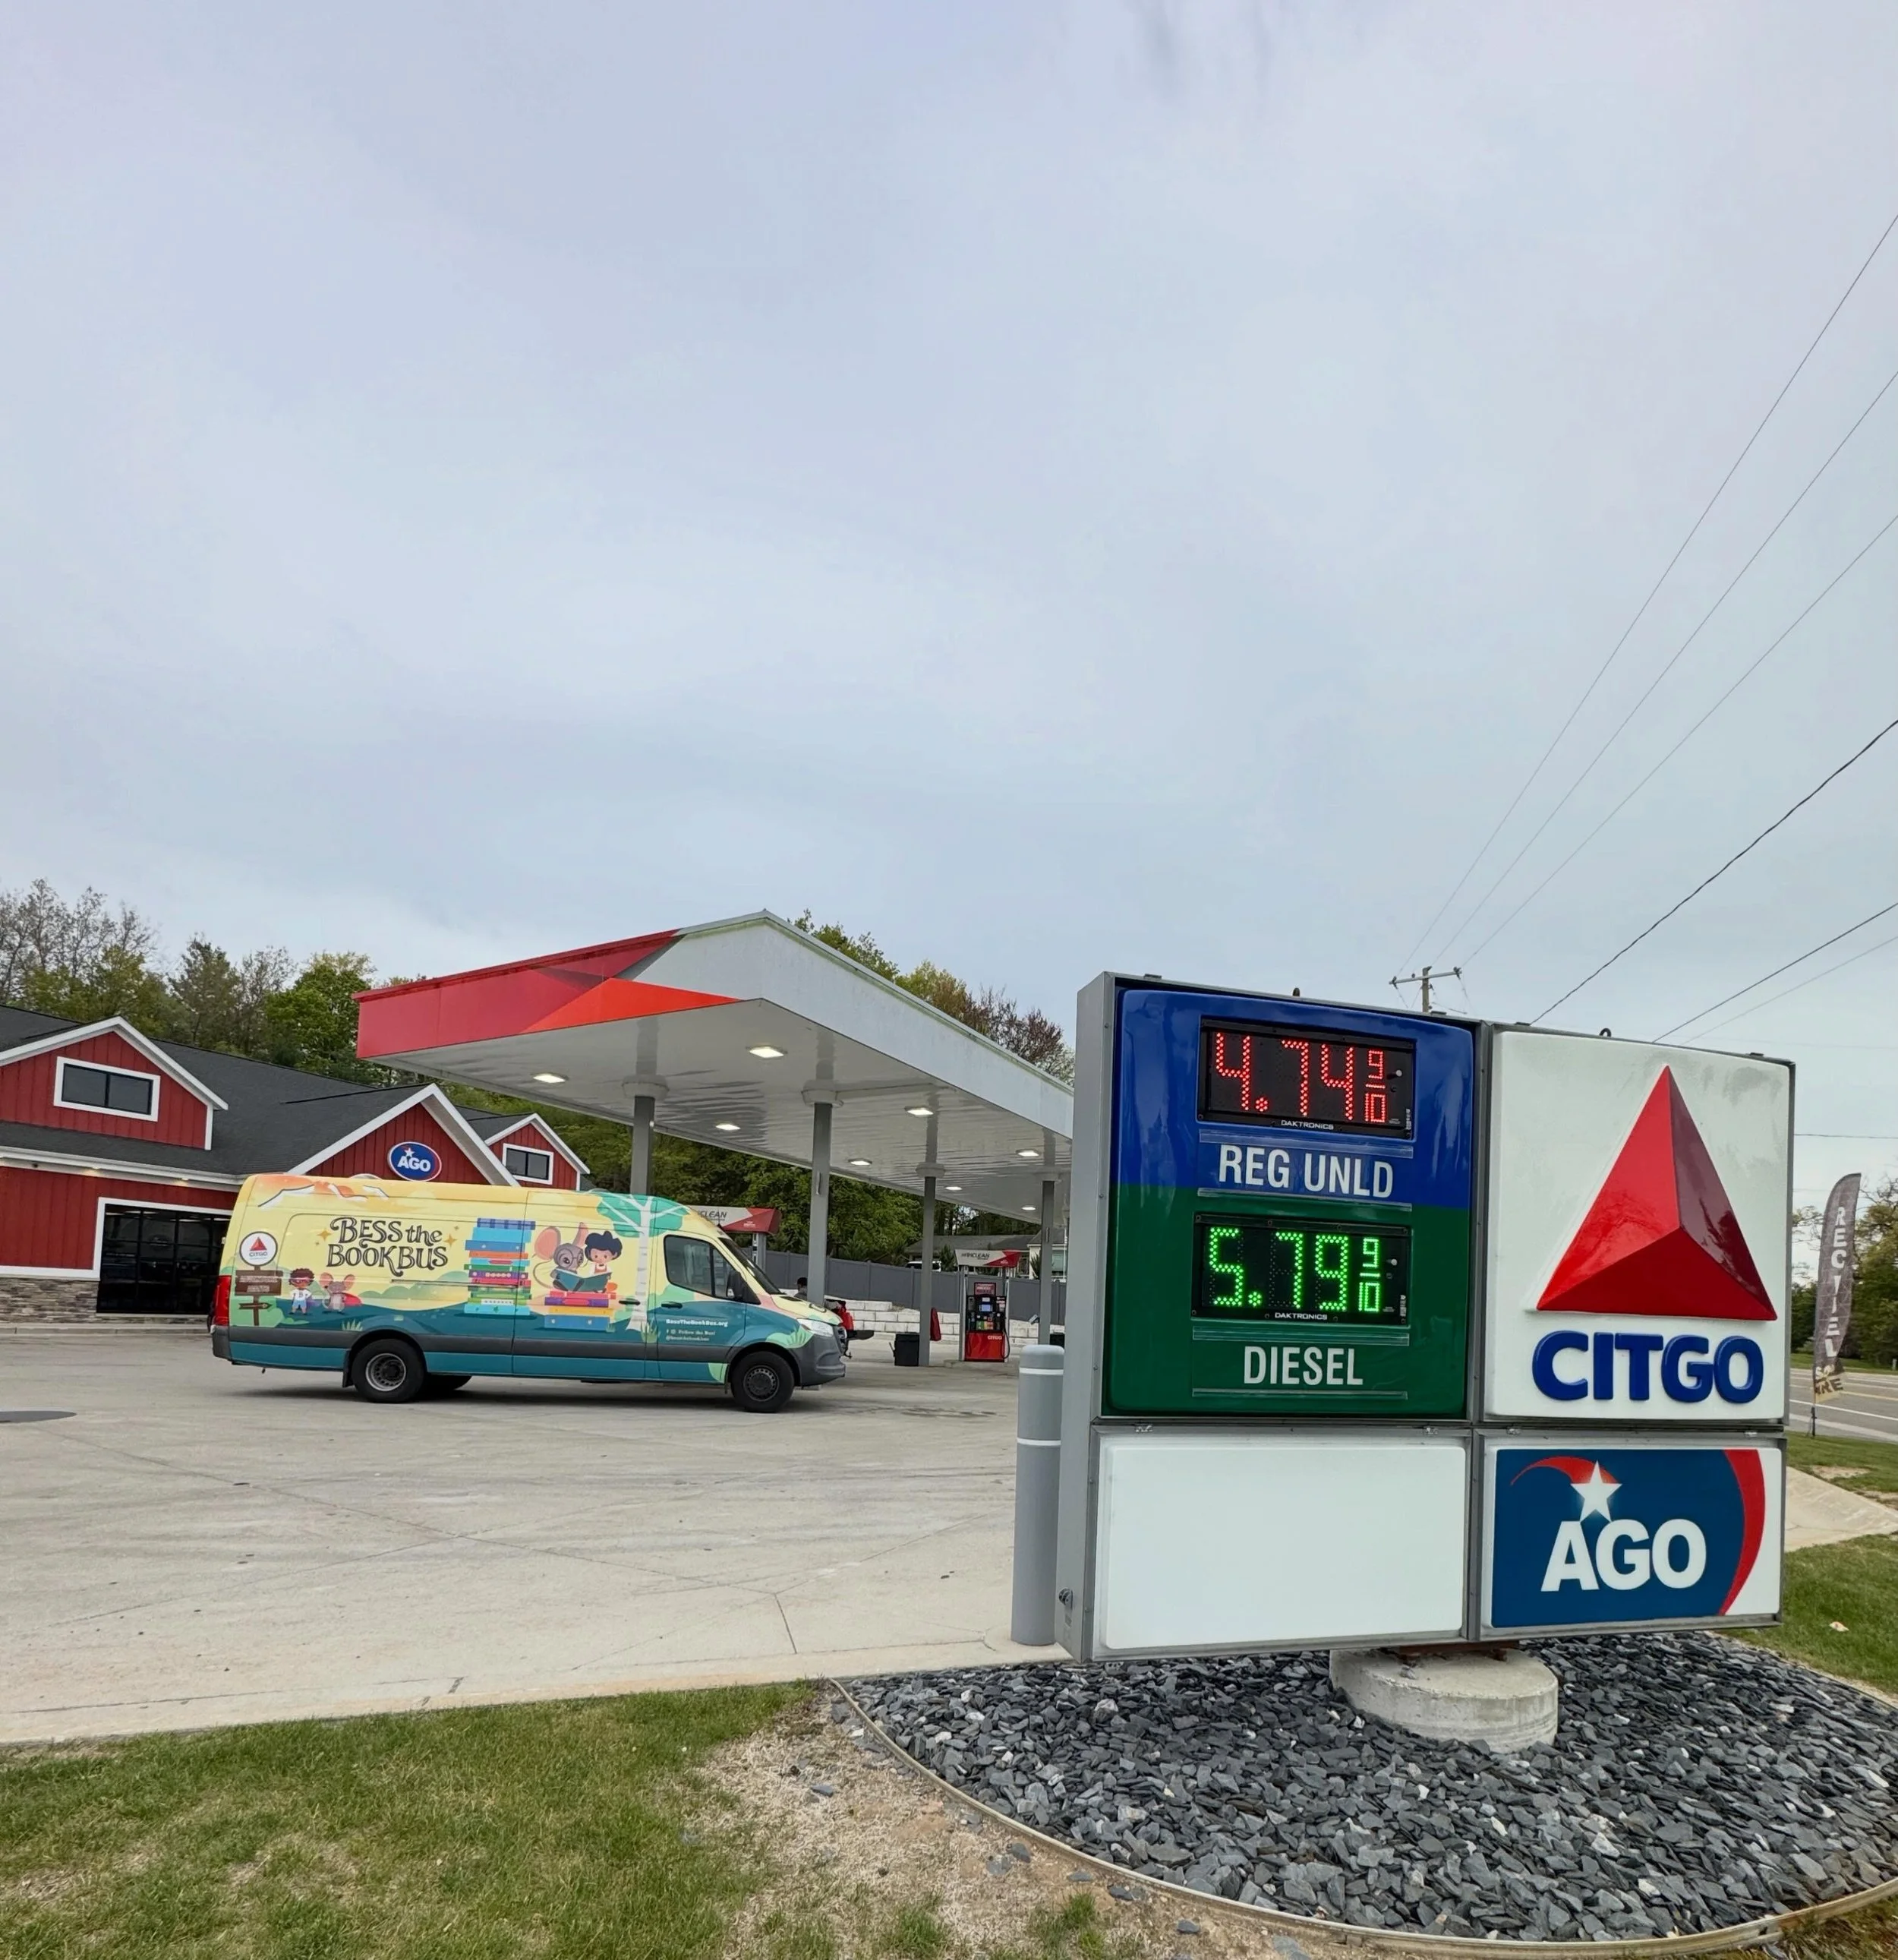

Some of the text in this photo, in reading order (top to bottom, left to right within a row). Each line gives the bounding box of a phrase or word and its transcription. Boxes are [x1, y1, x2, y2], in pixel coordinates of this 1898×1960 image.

[1215, 1032, 1354, 1121] 4.74
[1281, 1119, 1334, 1130] DAKTRONICS
[397, 1155, 431, 1172] AGO
[1219, 1144, 1394, 1198] REG UNLD
[330, 1217, 443, 1248] BESS the
[1209, 1227, 1349, 1311] 5.79
[1275, 1312, 1328, 1321] DAKTRONICS
[1244, 1346, 1364, 1386] DIESEL
[1532, 1330, 1764, 1404] CITGO
[1540, 1518, 1707, 1592] AGO
